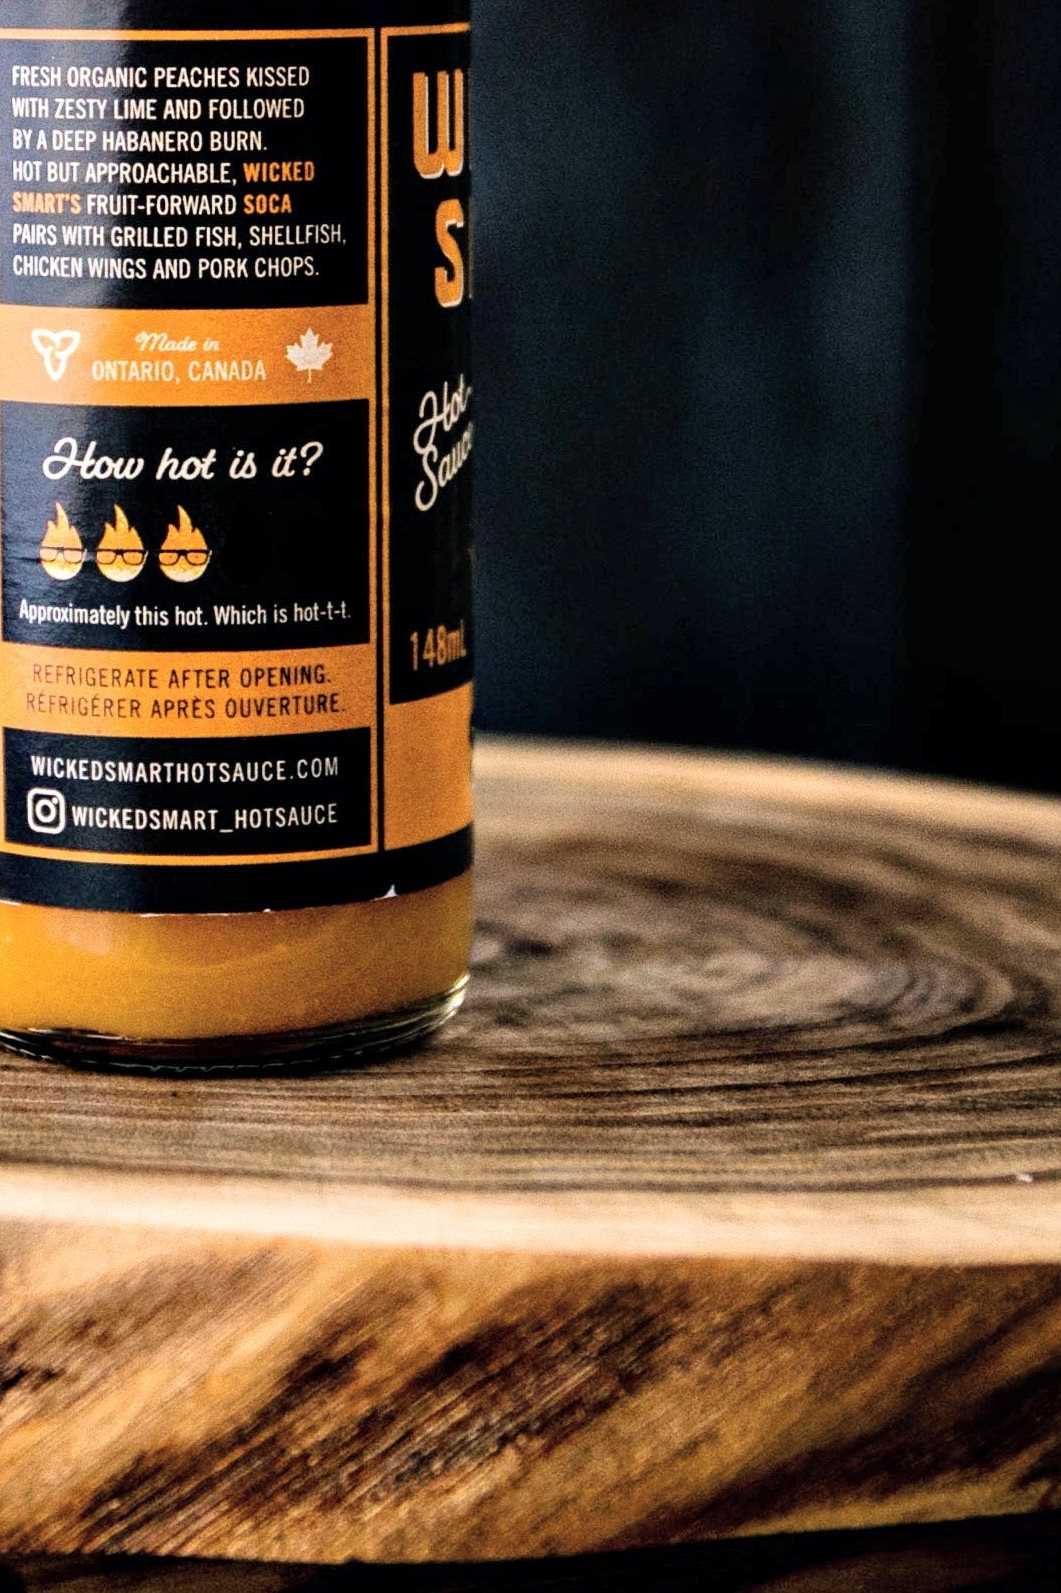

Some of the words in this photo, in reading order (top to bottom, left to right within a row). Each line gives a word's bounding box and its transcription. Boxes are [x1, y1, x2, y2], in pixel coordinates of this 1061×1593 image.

[11, 66, 62, 87] FRESH
[67, 67, 148, 88] ORGANIC
[154, 67, 240, 88] PEACHES
[246, 66, 310, 88] KISSED
[11, 97, 49, 119] WITH
[54, 98, 106, 119] ZESTY
[113, 99, 157, 120] LIME
[163, 99, 202, 120] AND
[208, 97, 304, 119] FOLLOWED
[11, 129, 34, 150] BY
[36, 130, 47, 150] A
[52, 131, 97, 151] DEEP
[102, 131, 203, 152] HABANERO
[209, 130, 267, 151] BURN.
[12, 161, 42, 181] HOT
[47, 162, 81, 182] BUT
[85, 162, 238, 185] APPROACHABLE,
[243, 161, 315, 182] WICKED
[12, 192, 81, 213] SMART'S
[87, 194, 237, 216] FRUIT-FORWARD
[243, 193, 292, 214] SOCA
[12, 224, 57, 246] PAIRS
[62, 225, 104, 247] WITH
[110, 226, 188, 248] GRILLED
[195, 226, 243, 249] FISH,
[249, 224, 347, 247] SHELLFISH,
[12, 255, 82, 277] CHICKEN
[87, 256, 147, 279] WINGS
[152, 257, 191, 279] AND
[197, 256, 249, 279] PORK
[254, 256, 320, 277] CHOPS.
[134, 331, 197, 352] Made
[202, 331, 220, 351] in
[91, 360, 181, 384] ONTARIO,
[187, 360, 266, 381] CANADA
[42, 436, 145, 480] How
[155, 447, 217, 481] hot
[228, 448, 257, 480] is
[272, 441, 324, 478] it?
[19, 599, 130, 629] Approximately
[134, 604, 170, 627] this
[174, 606, 208, 626] hot.
[214, 604, 267, 626] Which
[273, 603, 288, 624] is
[293, 601, 352, 623] hot-t-t.
[33, 664, 159, 689] REFRIGERATE
[168, 669, 229, 690] AFTER
[240, 664, 332, 688] OPENING.
[150, 693, 216, 719] APRÈS
[225, 693, 346, 718] OUVERTURE.
[30, 755, 339, 784] WICKEDSMARTHOTSAUCE.COM
[71, 804, 338, 833] WICKEDSMART_HOTSAUCE
